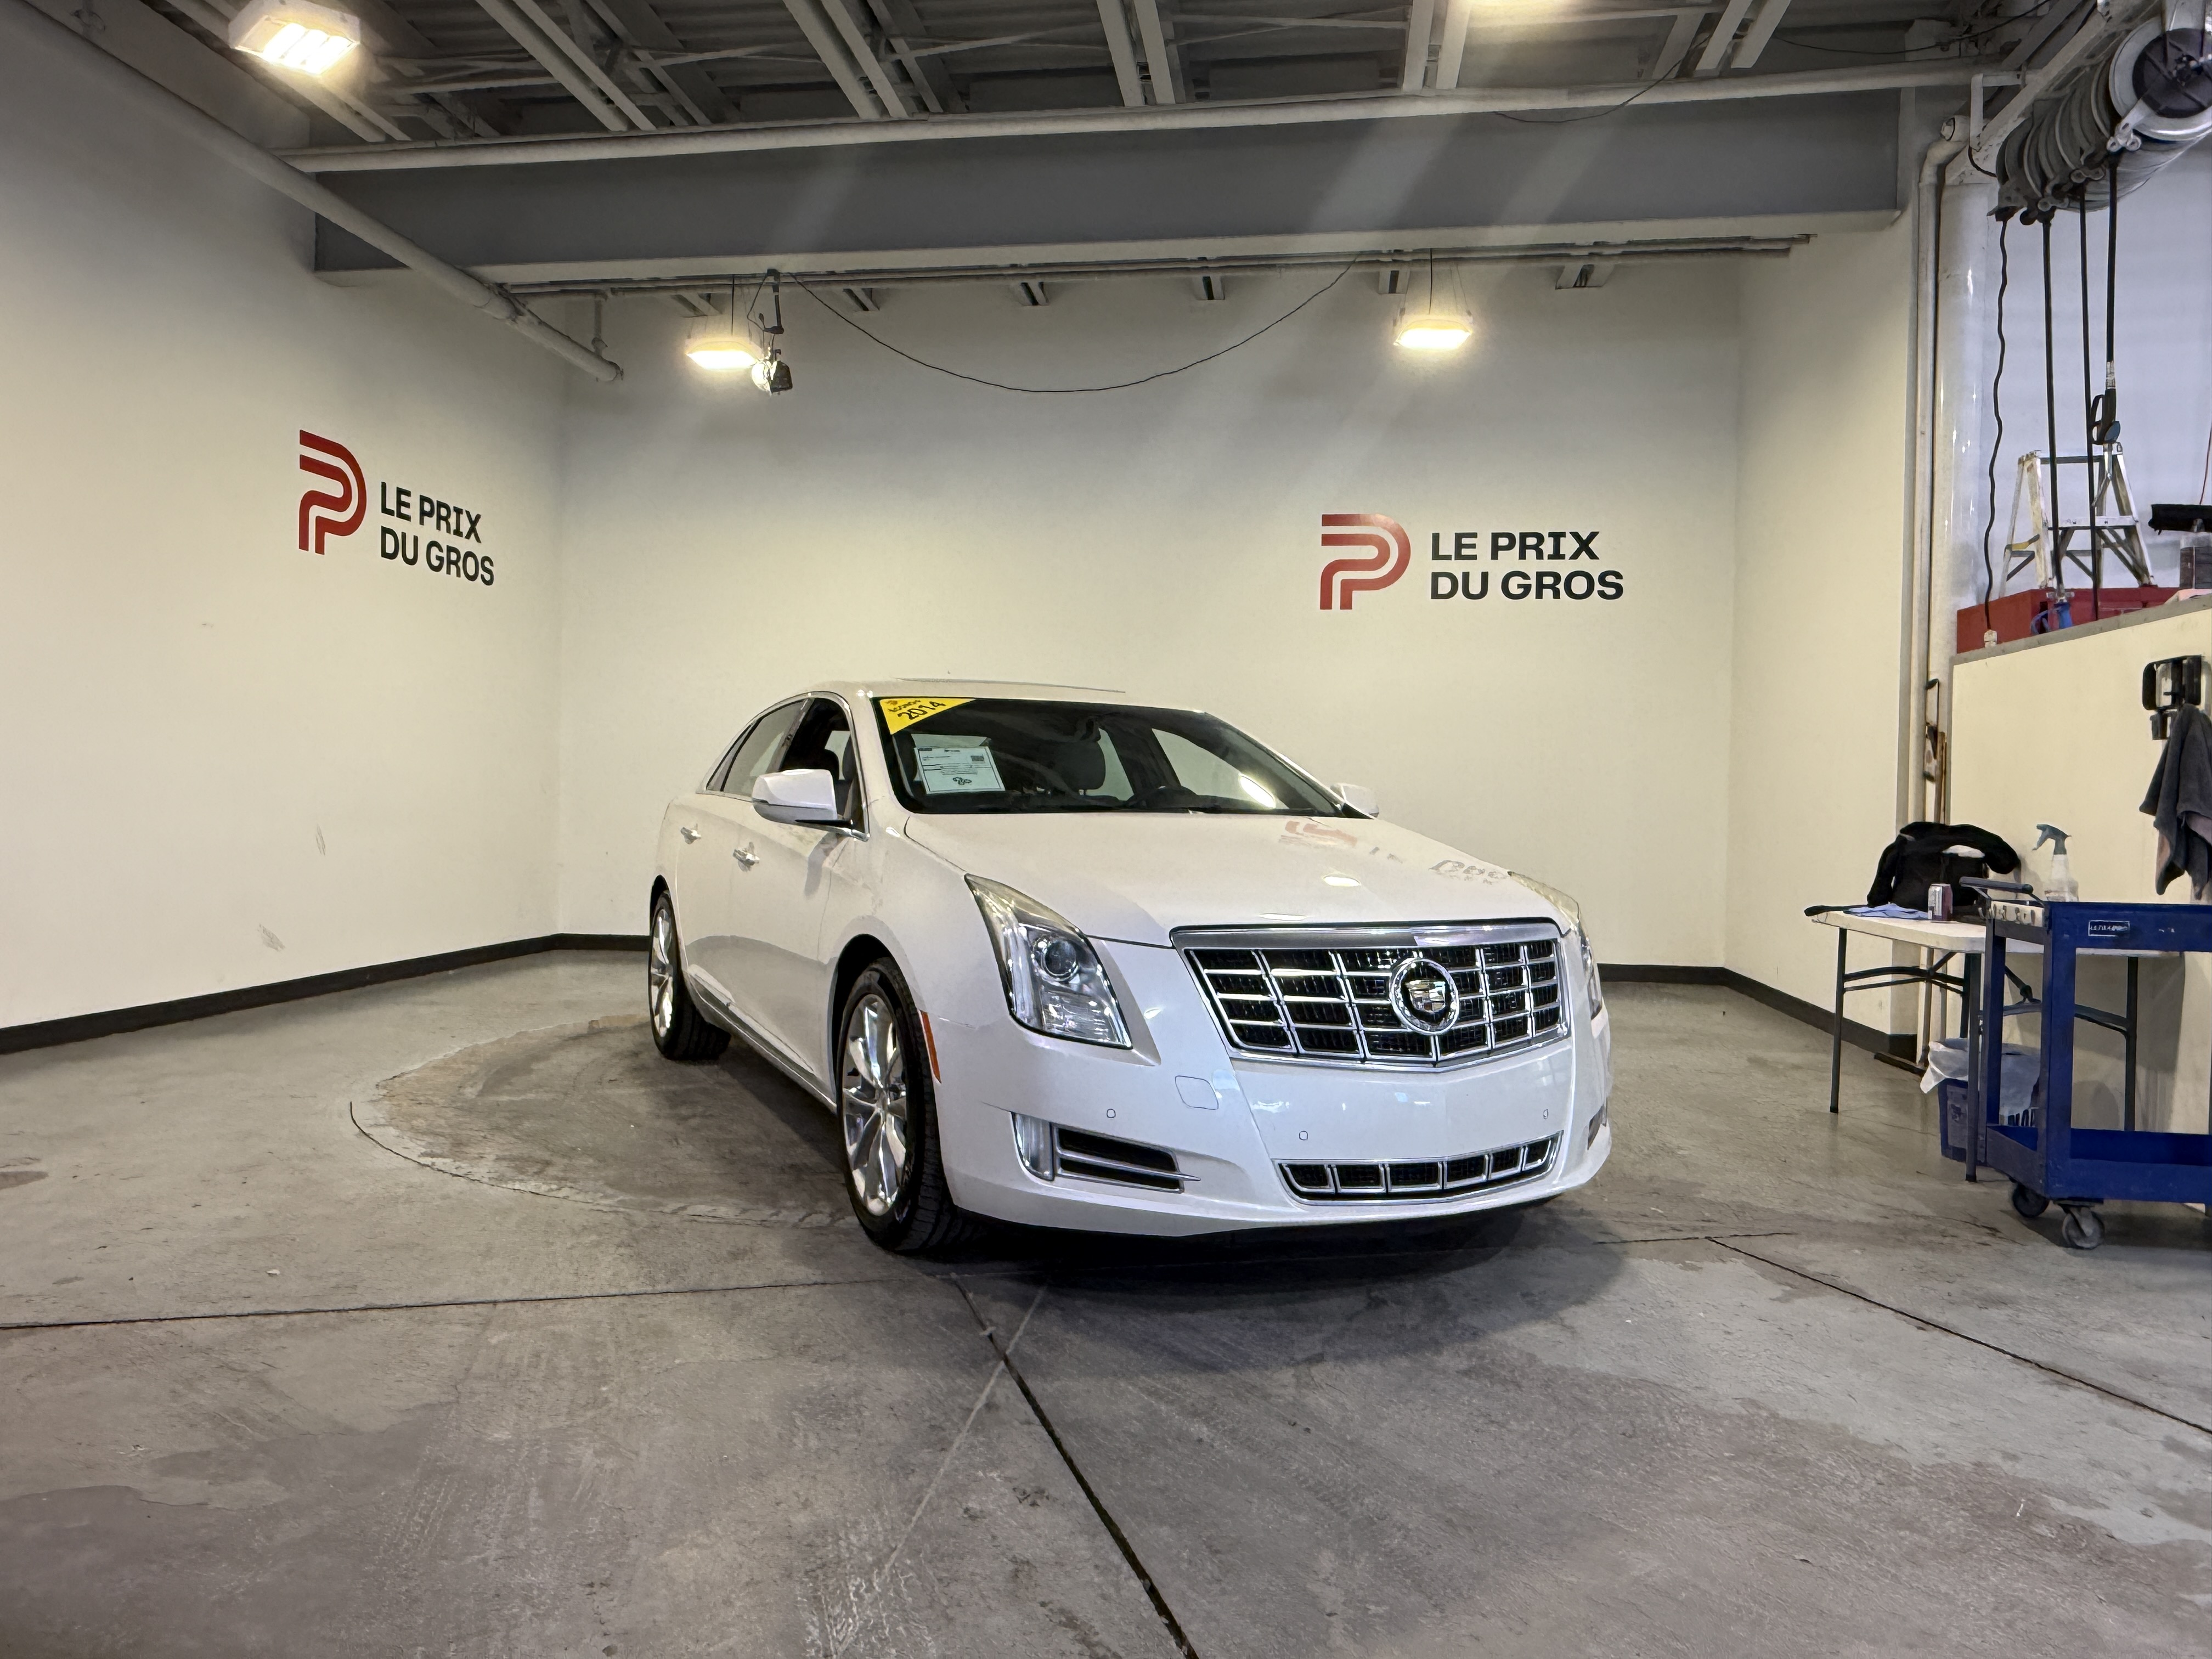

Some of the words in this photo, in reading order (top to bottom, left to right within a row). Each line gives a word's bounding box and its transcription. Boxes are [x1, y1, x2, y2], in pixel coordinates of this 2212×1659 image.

[381, 481, 411, 522] LE
[419, 494, 482, 544] PRIX
[381, 526, 419, 566] DU
[426, 540, 494, 586] GROS
[1431, 532, 1478, 561] LE
[1491, 531, 1600, 561] PRIX
[1431, 571, 1489, 600] DU
[1501, 570, 1623, 600] GROS
[897, 701, 946, 720] 2014
